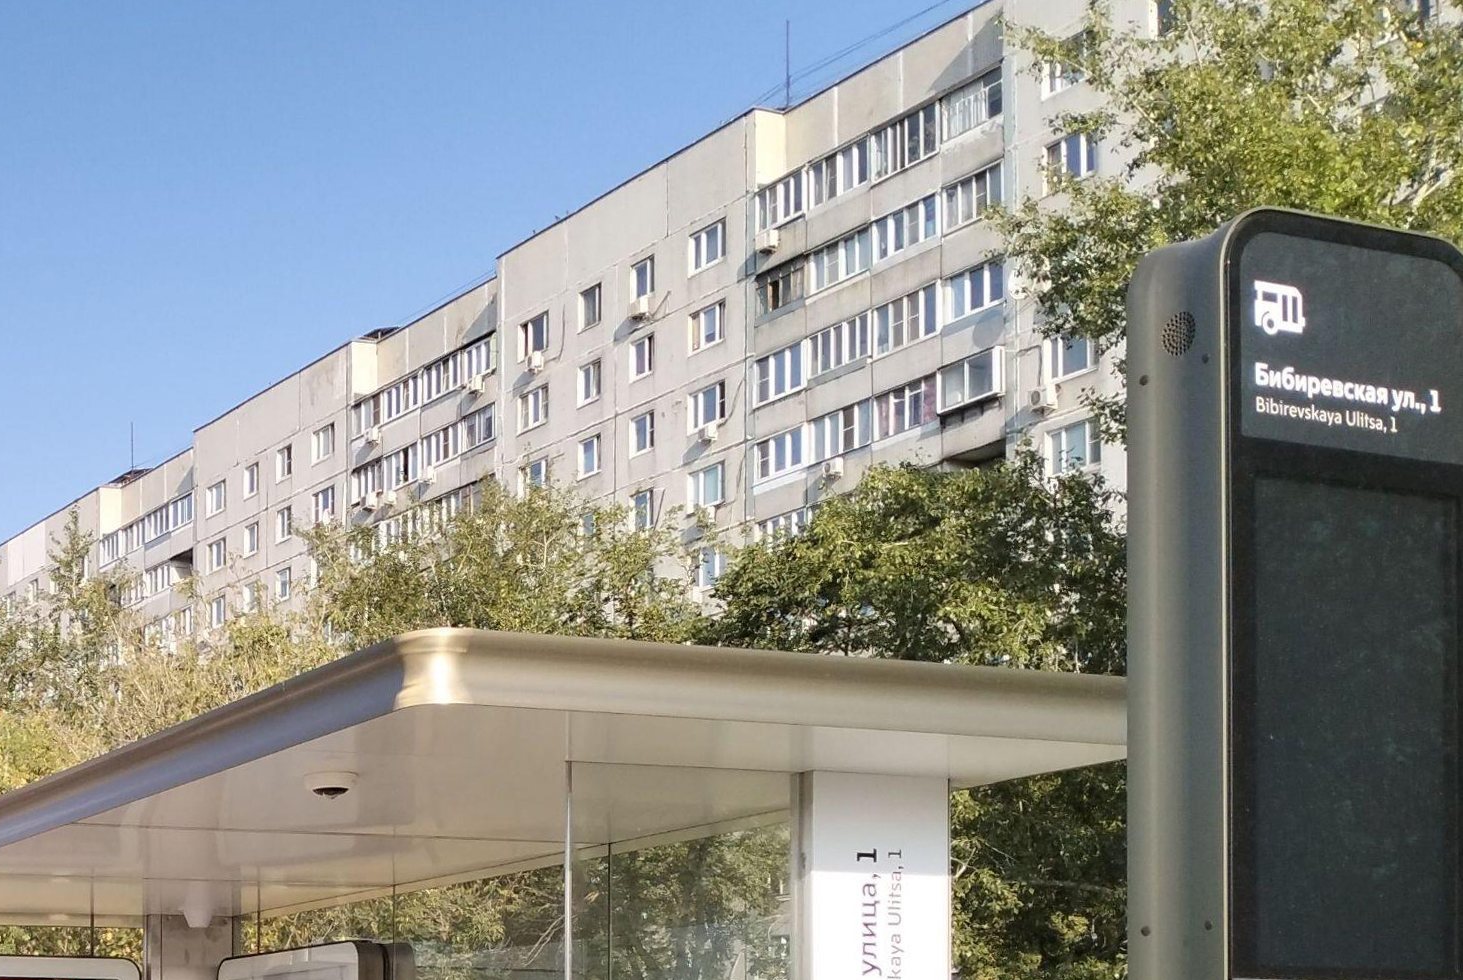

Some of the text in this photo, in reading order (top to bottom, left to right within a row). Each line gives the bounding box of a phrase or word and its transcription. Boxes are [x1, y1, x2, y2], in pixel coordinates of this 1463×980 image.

[1254, 361, 1442, 415] Бибиревская ул., 1
[1255, 395, 1398, 434] Bibirevskaya Ulitsa, 1
[856, 847, 878, 864] 1
[887, 848, 902, 860] 1
[886, 866, 903, 926] Ulitsa,
[859, 872, 882, 977] улица,
